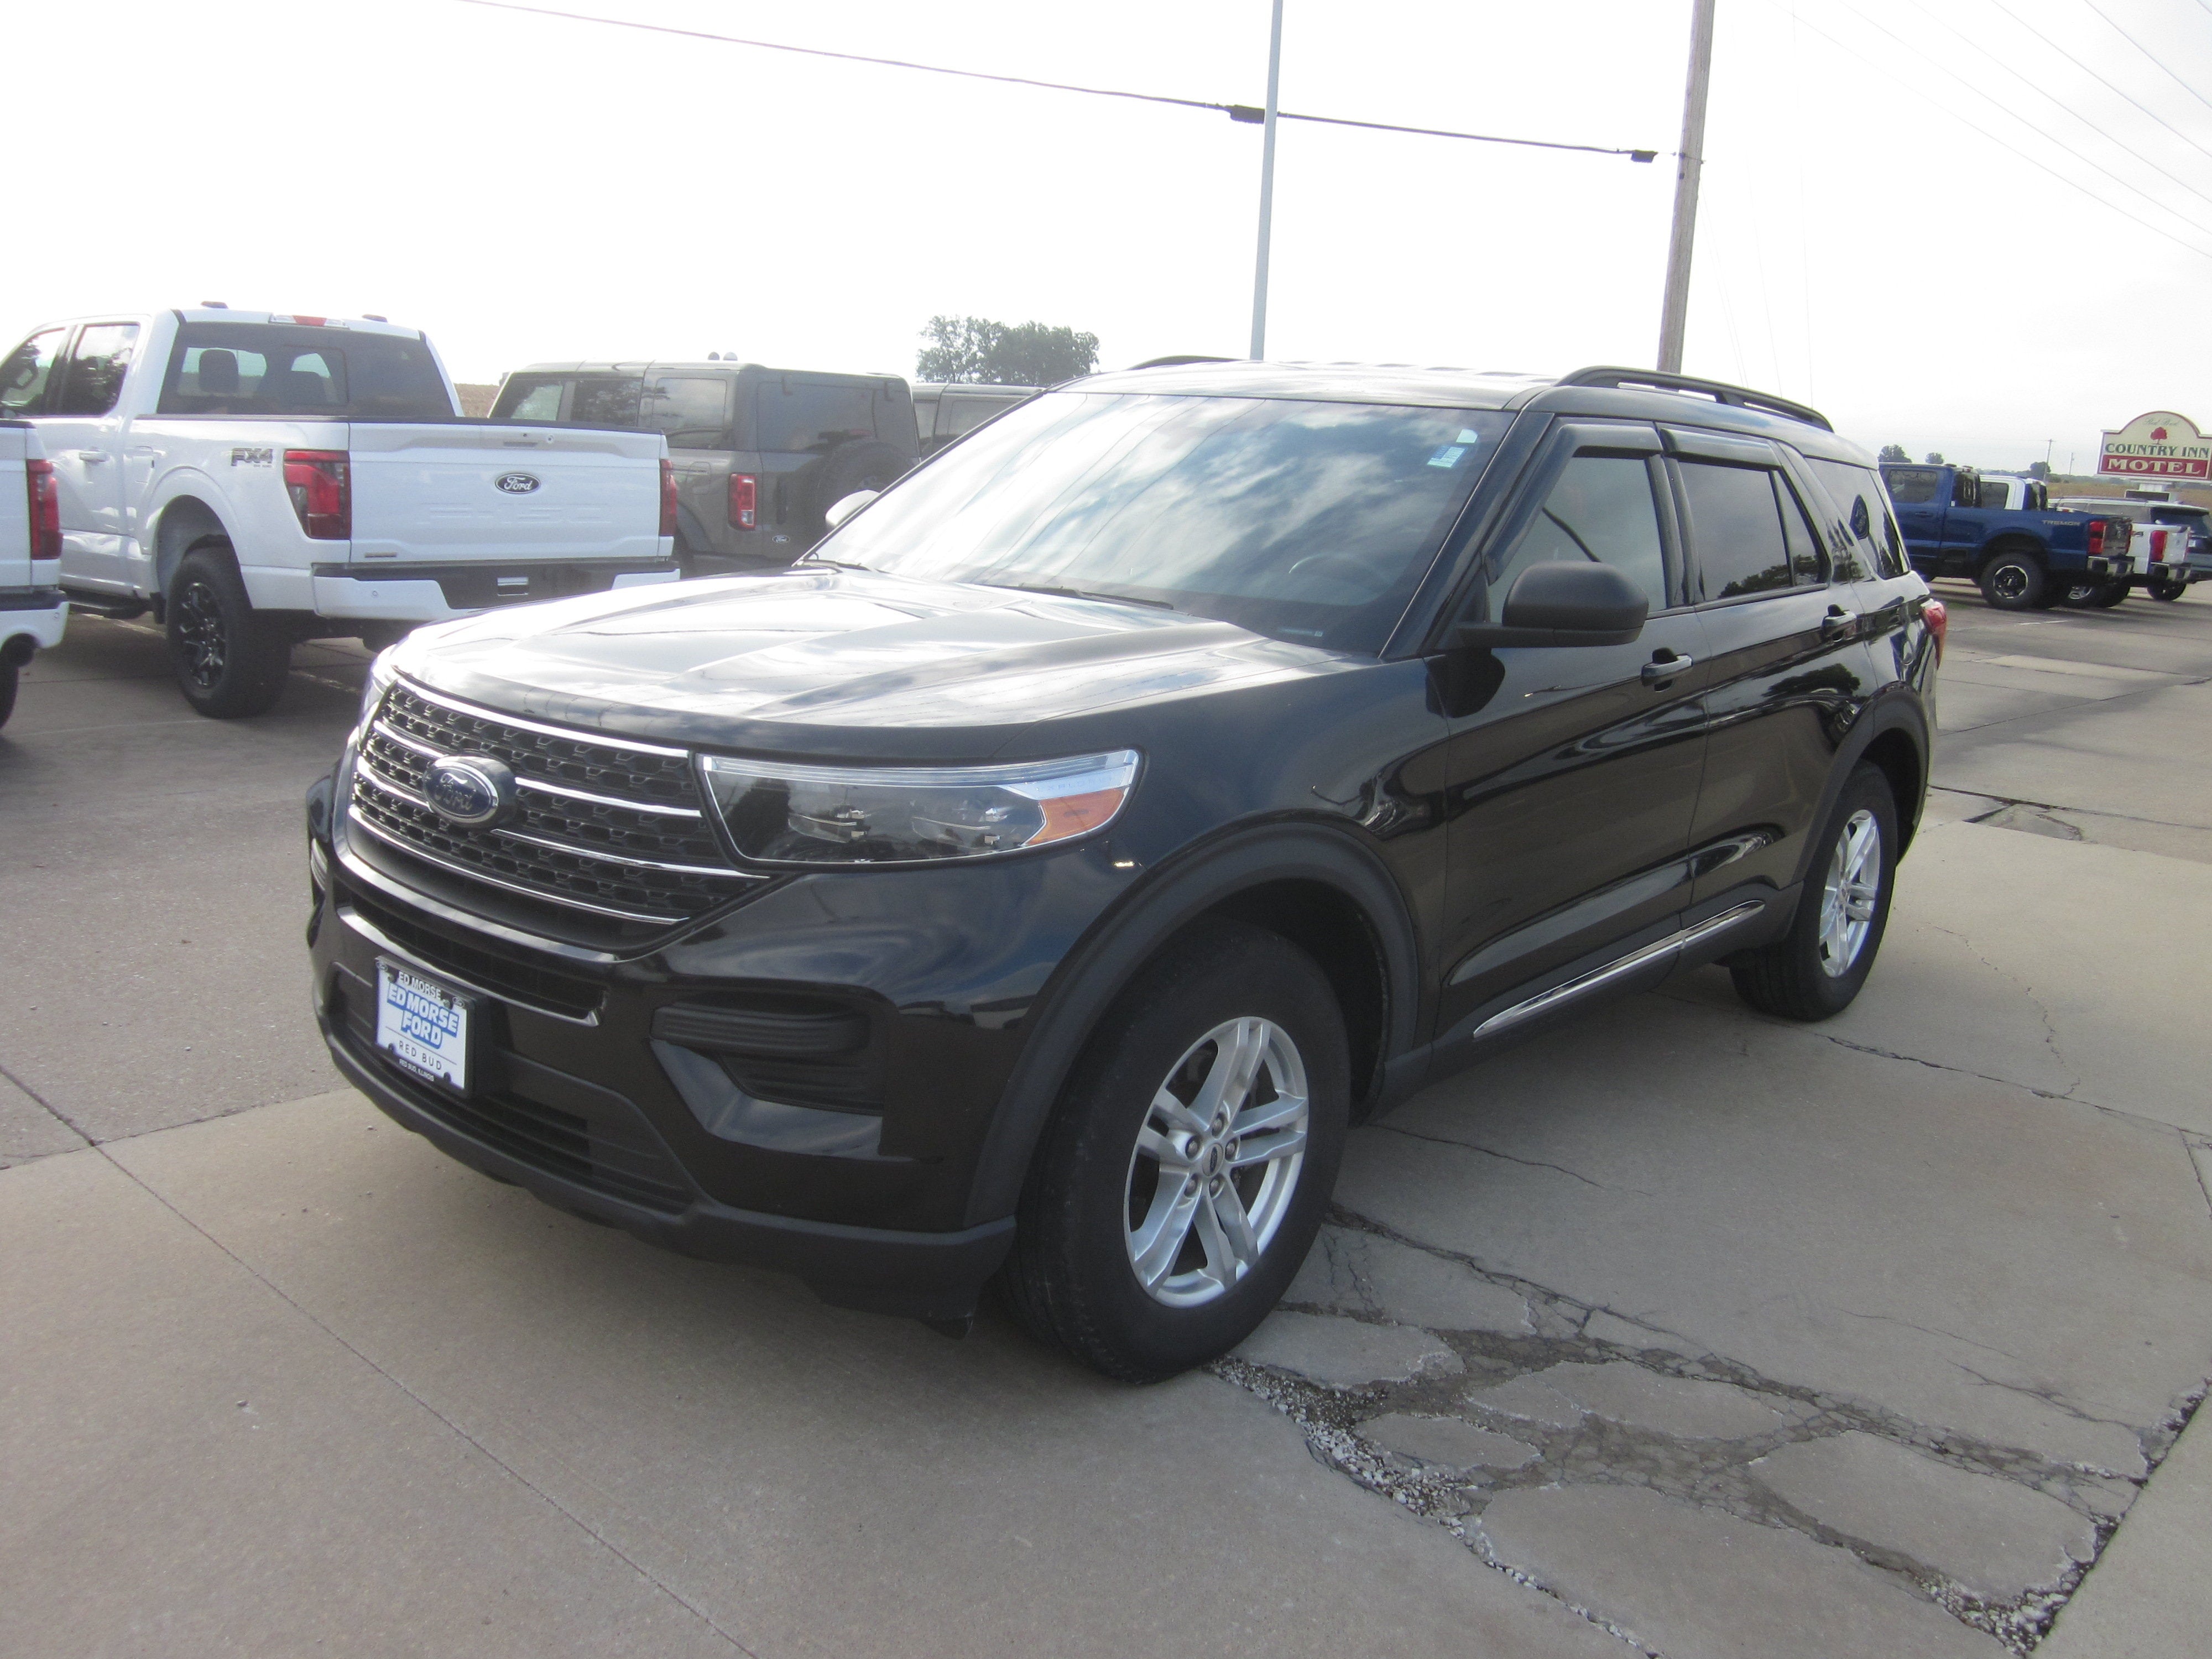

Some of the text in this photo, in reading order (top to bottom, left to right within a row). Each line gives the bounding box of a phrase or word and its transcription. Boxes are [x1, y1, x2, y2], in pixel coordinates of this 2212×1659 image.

[231, 447, 273, 466] FX4
[2105, 443, 2210, 458] COUNTRY INN
[2107, 458, 2201, 474] MOTEL
[504, 476, 533, 490] Ford
[398, 971, 442, 1000] ED MORSE
[388, 983, 460, 1036] ED MORSE
[401, 1011, 443, 1048] FORD
[399, 1040, 442, 1070] RED BUD
